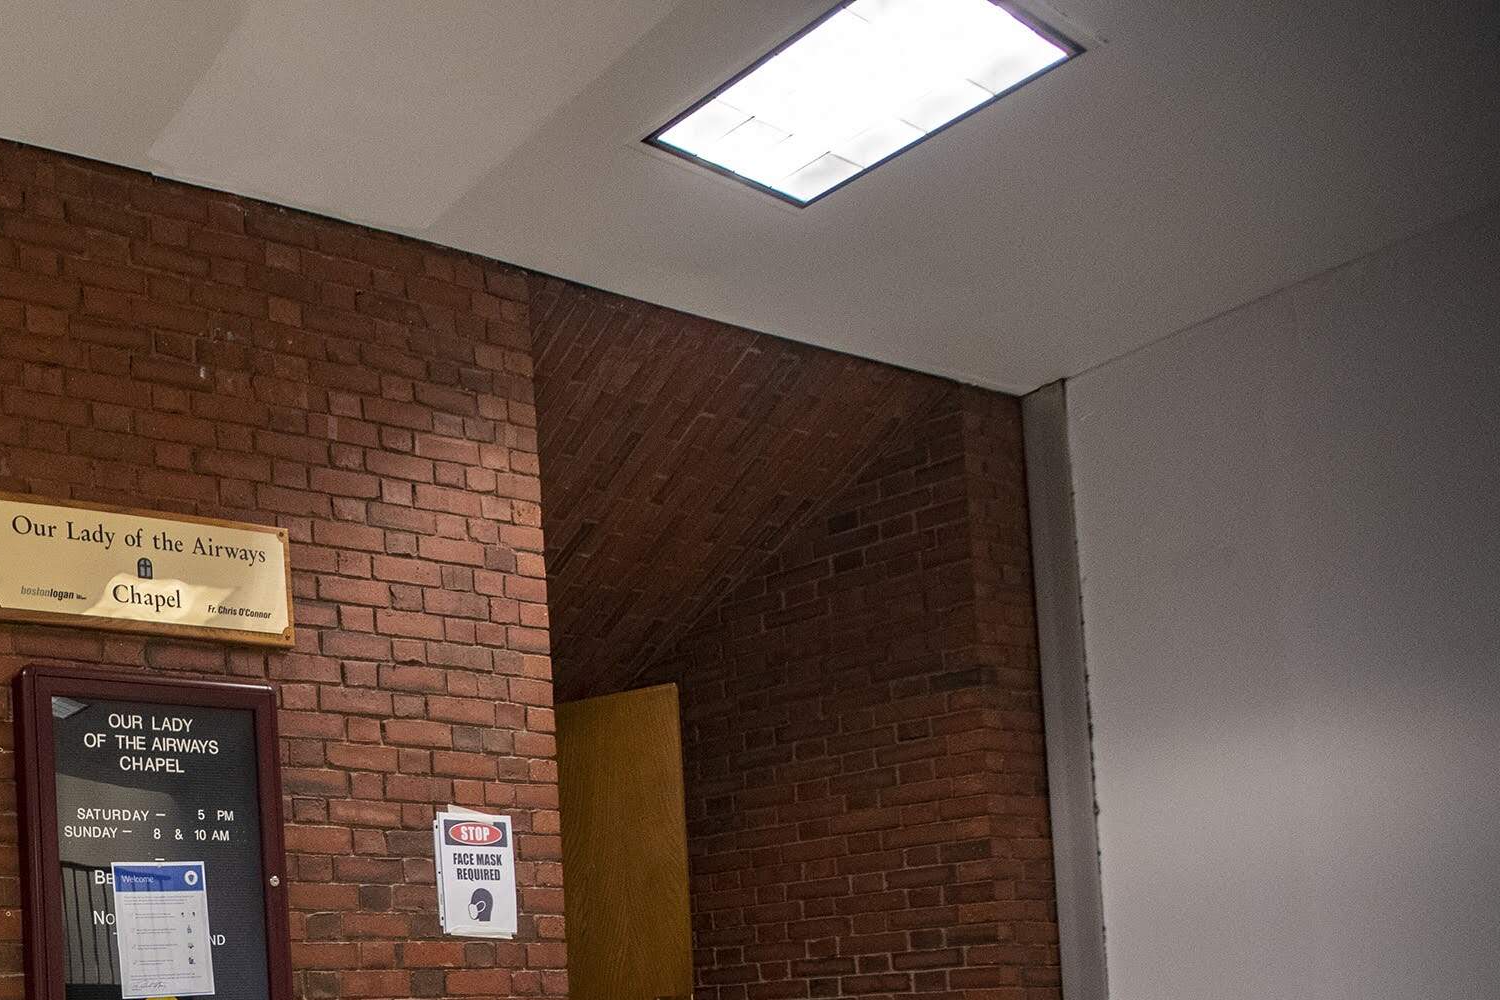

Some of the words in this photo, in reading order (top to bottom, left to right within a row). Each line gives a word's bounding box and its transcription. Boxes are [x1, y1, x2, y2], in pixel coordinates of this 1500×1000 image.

[12, 515, 57, 538] Our
[66, 520, 115, 549] Lady
[124, 528, 142, 548] of
[152, 532, 184, 552] the
[192, 537, 266, 566] Airways
[112, 584, 182, 612] Chapel
[208, 604, 217, 614] Fr.
[218, 606, 237, 616] Chris
[238, 608, 271, 619] O'Connor
[108, 714, 143, 730] OUR
[152, 716, 193, 732] LADY
[84, 732, 106, 748] OF
[115, 735, 146, 750] THE
[152, 737, 218, 754] AIRWAYS
[120, 756, 184, 772] CHAPEL
[77, 808, 150, 822] SATURDAY
[198, 810, 205, 820] 5
[218, 810, 234, 821] PM
[64, 826, 118, 838] SUNDAY
[154, 829, 160, 840] 8
[175, 830, 183, 840] &
[194, 830, 206, 840] 10
[212, 830, 230, 841] AM
[461, 826, 490, 840] STOP
[453, 853, 474, 865] FACE
[476, 854, 502, 866] MASK
[121, 874, 154, 884] Welcome
[457, 868, 500, 881] REQUIRED
[209, 934, 226, 946] ND
